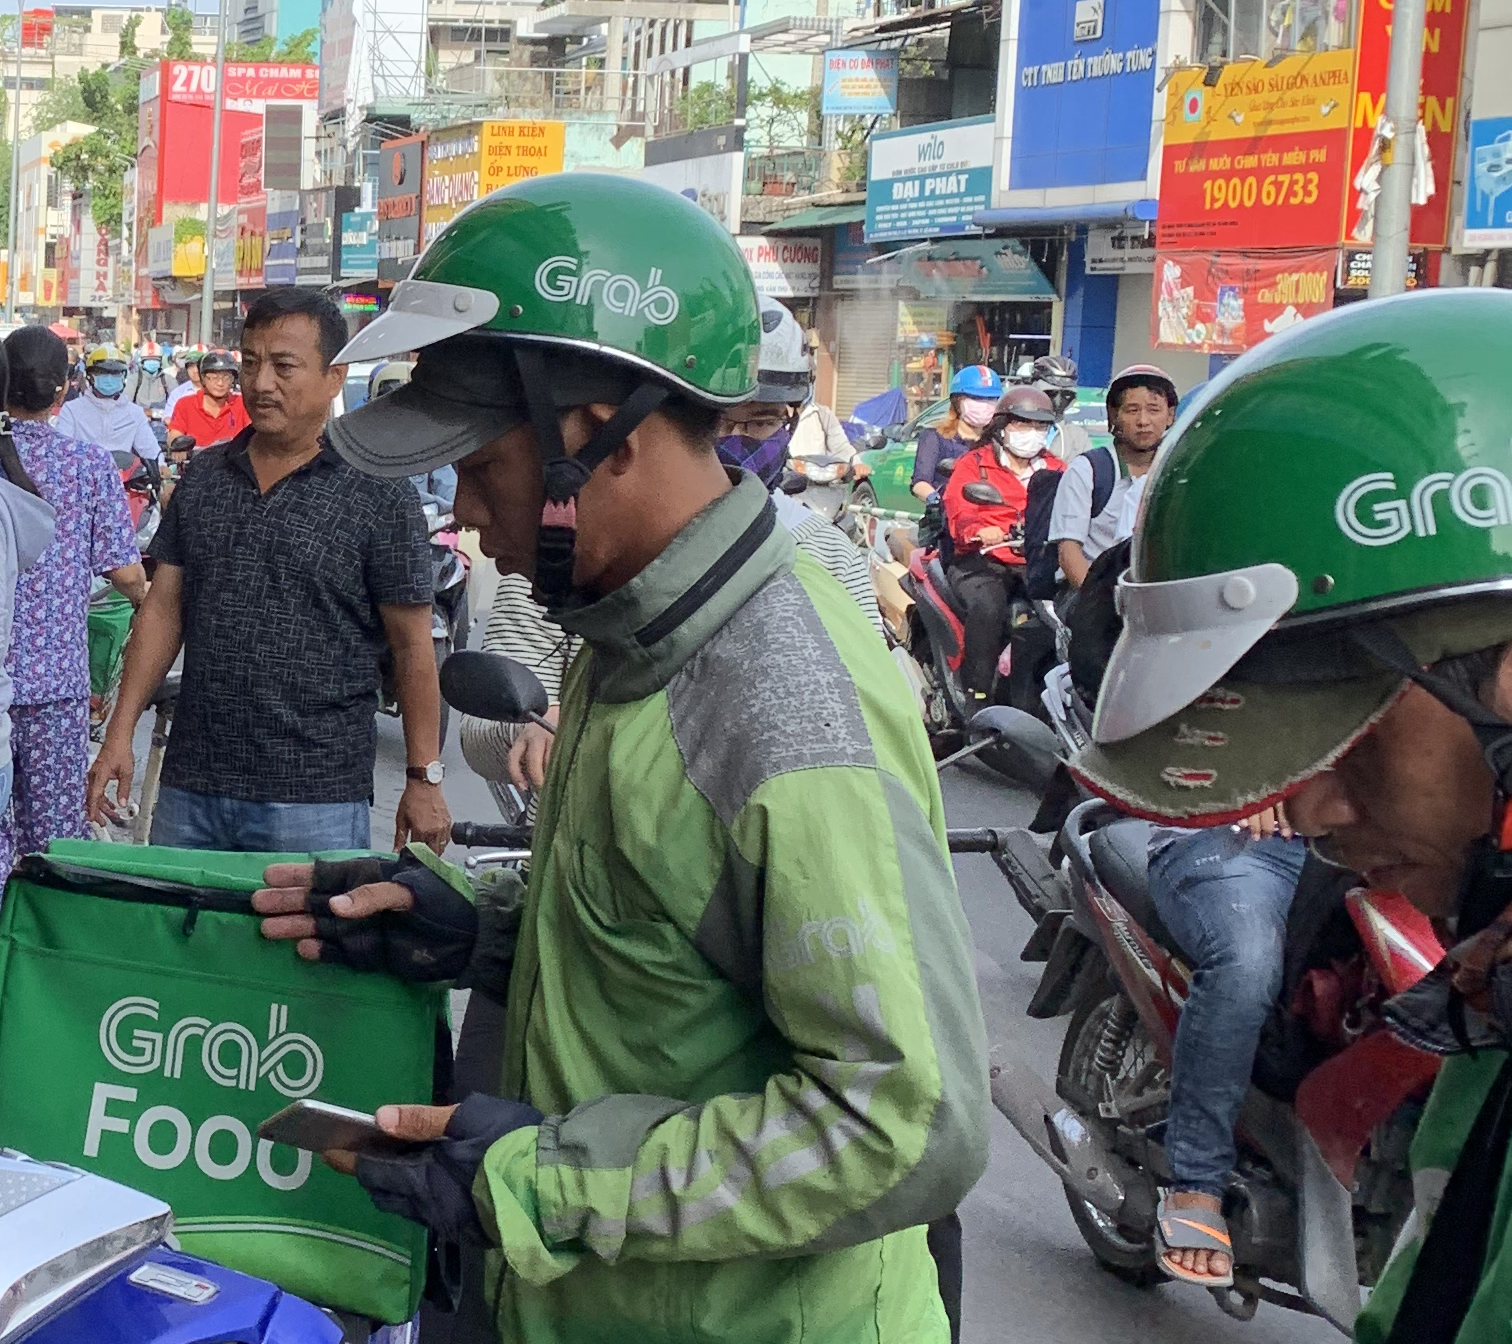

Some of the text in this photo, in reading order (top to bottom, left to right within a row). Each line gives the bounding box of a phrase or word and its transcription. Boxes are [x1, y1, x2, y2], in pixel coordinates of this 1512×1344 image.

[172, 64, 216, 93] 270
[228, 67, 255, 77] SPA
[490, 126, 515, 137] LINH
[917, 134, 944, 162] wilo
[892, 173, 969, 201] ĐẠI PHÁT
[1203, 171, 1319, 211] 1900 6733
[534, 255, 680, 326] Grab
[1334, 465, 1512, 547] Gra
[98, 995, 325, 1099] Grab
